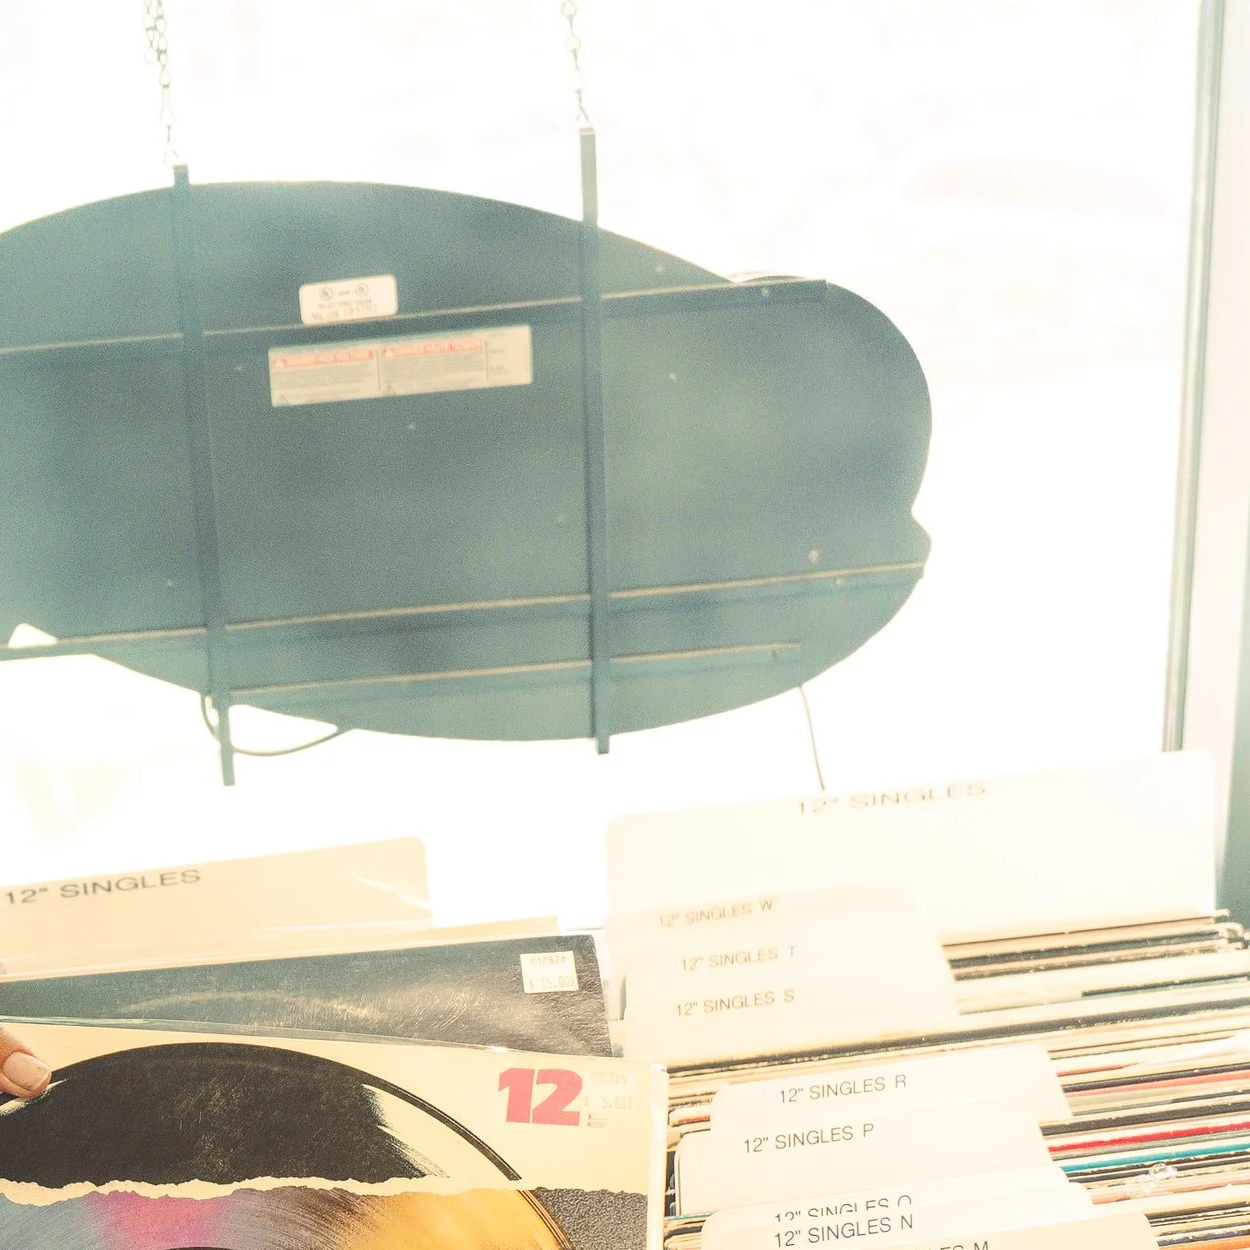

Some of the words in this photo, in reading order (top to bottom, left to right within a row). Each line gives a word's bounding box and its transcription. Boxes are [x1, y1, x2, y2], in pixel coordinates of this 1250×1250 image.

[798, 797, 839, 815] 12"
[849, 781, 987, 809] SINGLES
[4, 886, 49, 905] 12"
[60, 869, 201, 899] SINGLES
[658, 912, 681, 928] 12"
[684, 904, 752, 925] SINGLES
[759, 899, 774, 911] W
[681, 956, 704, 971] 12"
[708, 946, 779, 968] SINGLES
[788, 944, 798, 958] T
[676, 1001, 698, 1017] 12"
[702, 991, 776, 1014] SINGLES
[783, 988, 795, 1004] S
[498, 1067, 583, 1126] 12
[780, 1087, 804, 1104] 12"
[809, 1076, 886, 1100] SINGLES
[894, 1073, 908, 1089] R
[743, 1135, 769, 1154] 12"
[775, 1125, 854, 1150] SINGLES
[862, 1123, 874, 1138] P
[807, 1197, 890, 1218] SINGLES
[774, 1230, 801, 1248] 12"
[807, 1217, 892, 1244] SINGLES
[900, 1214, 914, 1231] N
